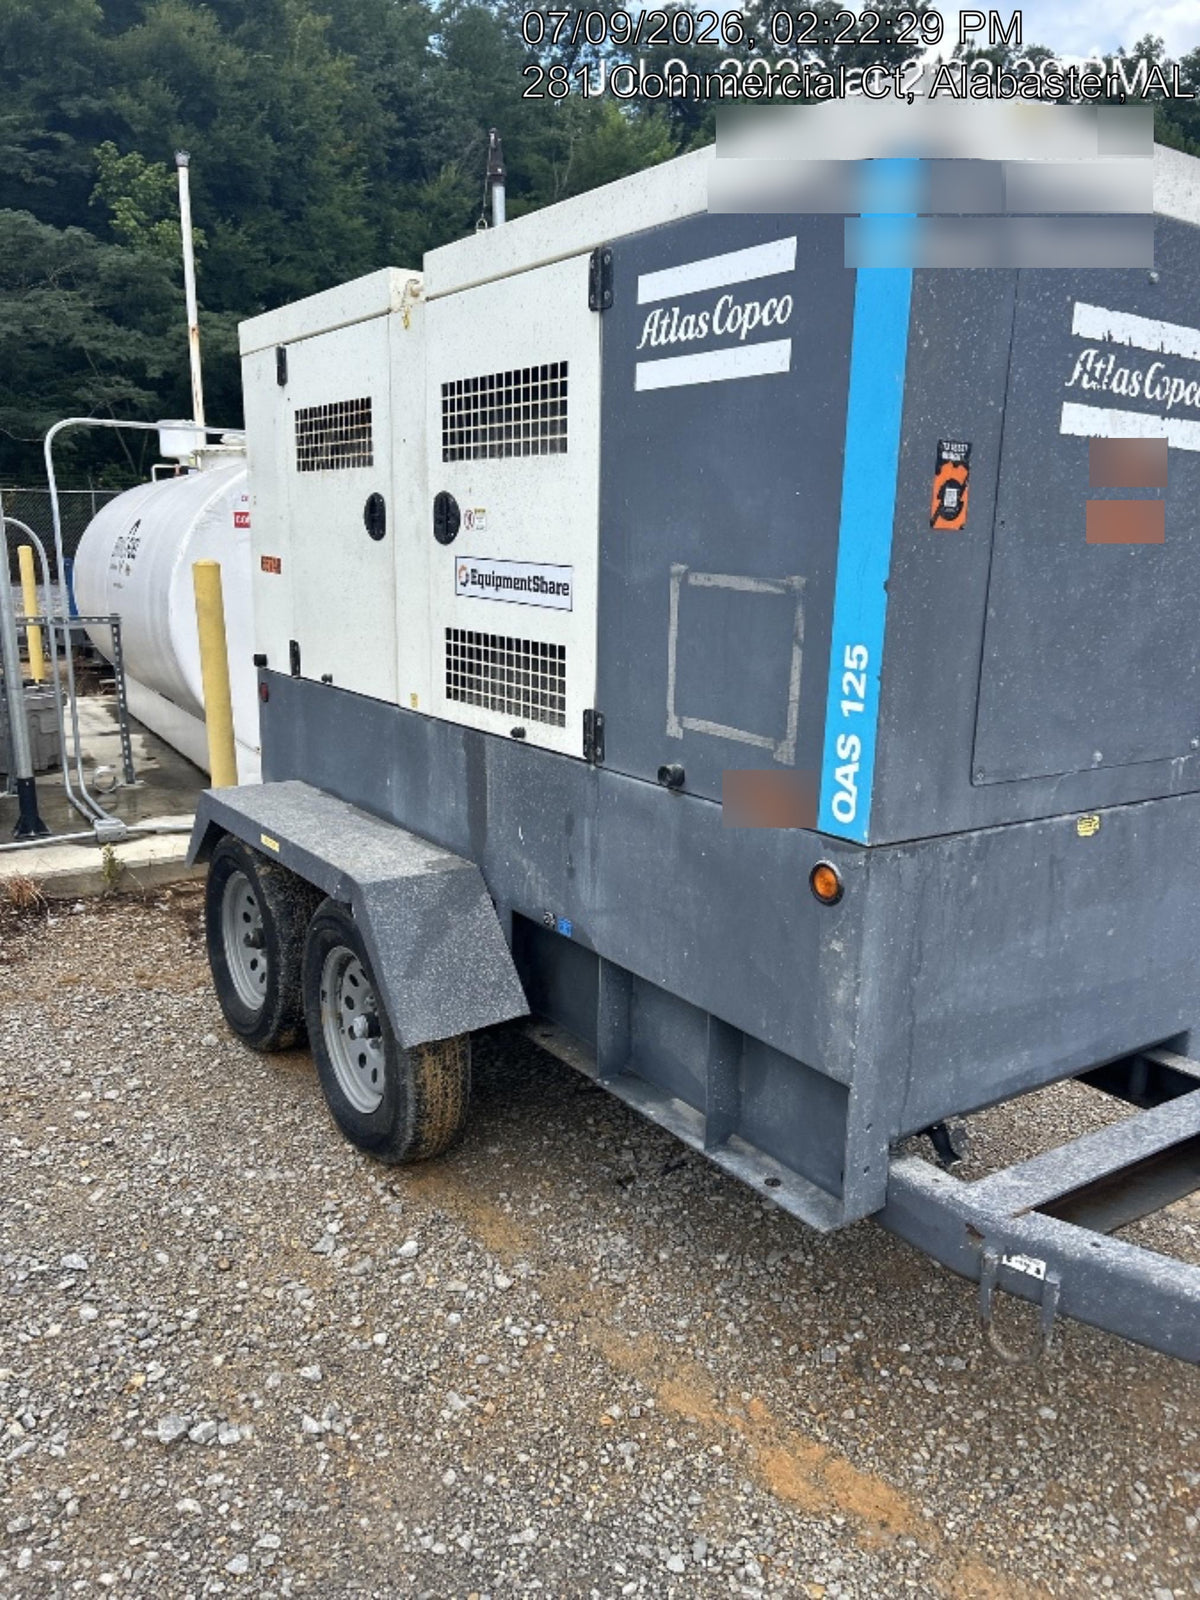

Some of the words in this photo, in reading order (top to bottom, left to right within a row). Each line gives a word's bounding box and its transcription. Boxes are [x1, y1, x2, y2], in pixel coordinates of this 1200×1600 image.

[636, 306, 710, 350] Atlas
[712, 294, 794, 341] Copco
[1064, 347, 1143, 398] Atlas
[470, 568, 570, 597] EquipmentShare
[840, 644, 869, 718] 125
[831, 733, 862, 824] QAS
